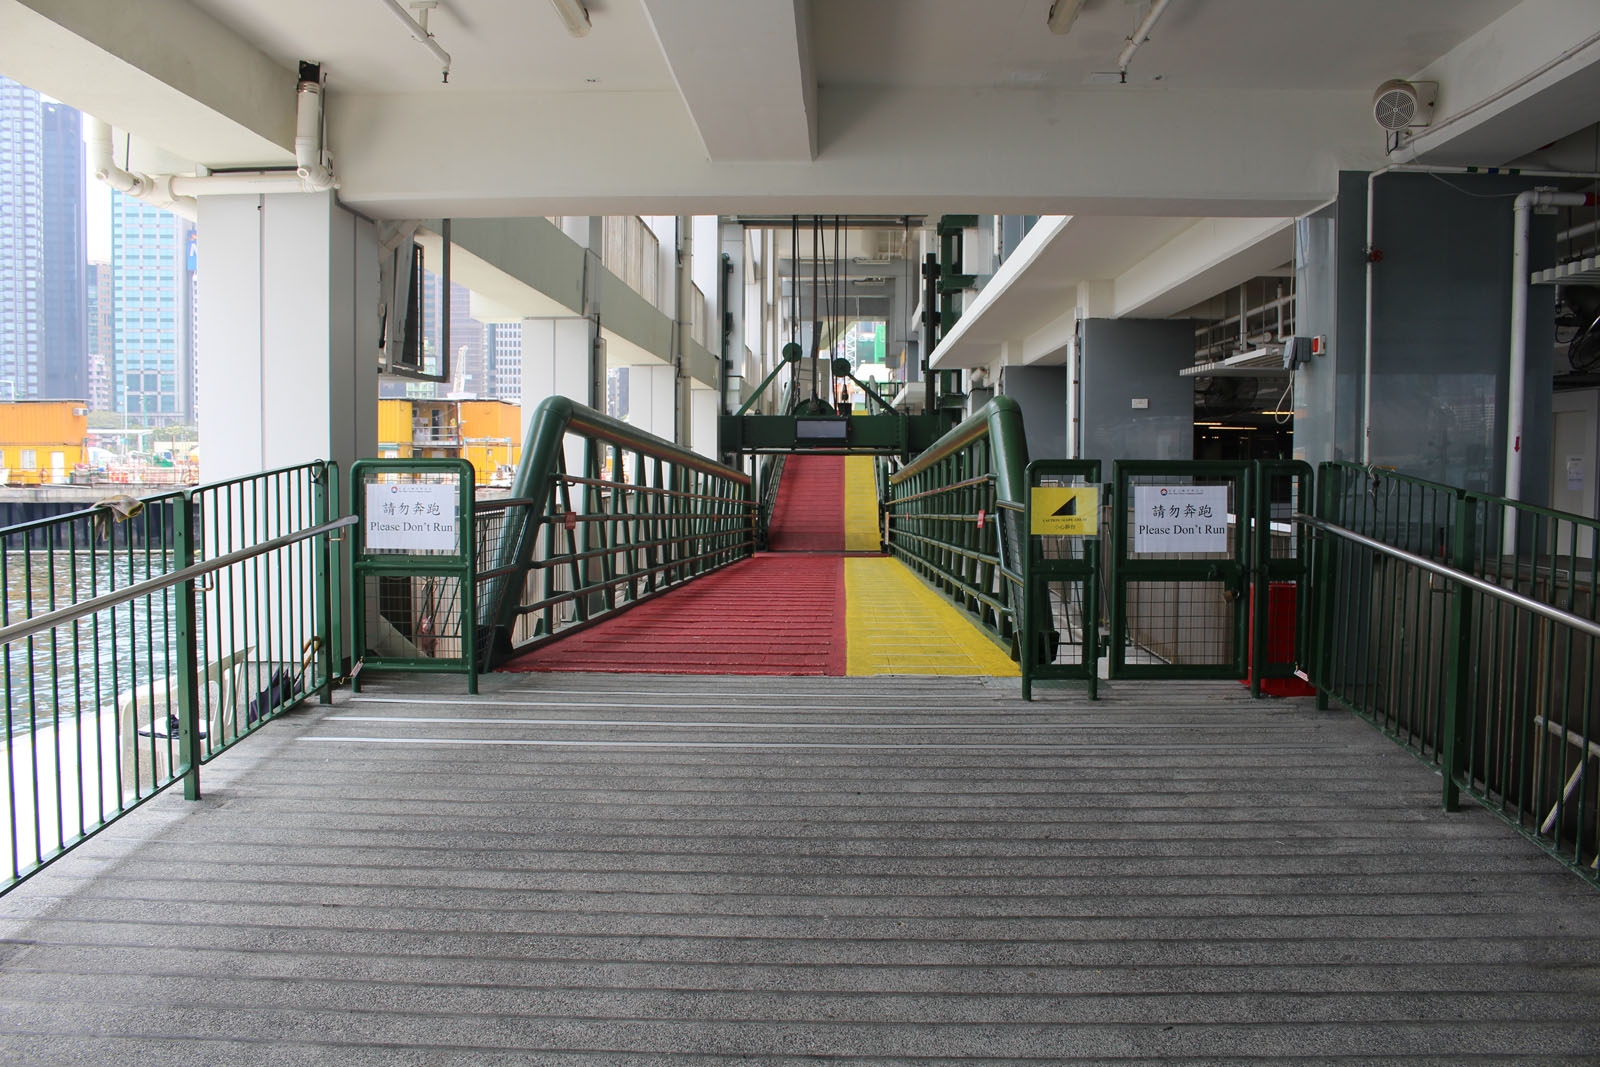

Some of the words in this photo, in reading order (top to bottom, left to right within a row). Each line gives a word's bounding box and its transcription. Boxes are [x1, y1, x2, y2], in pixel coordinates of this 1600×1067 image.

[383, 501, 441, 516] 請勿奔跑
[1152, 503, 1213, 519] 請勿奔跑
[370, 521, 401, 532] Please
[403, 521, 430, 532] Don't
[433, 522, 453, 532] Run
[1139, 524, 1171, 535] Please
[1173, 524, 1202, 535] Don't
[1205, 524, 1225, 535] Run
